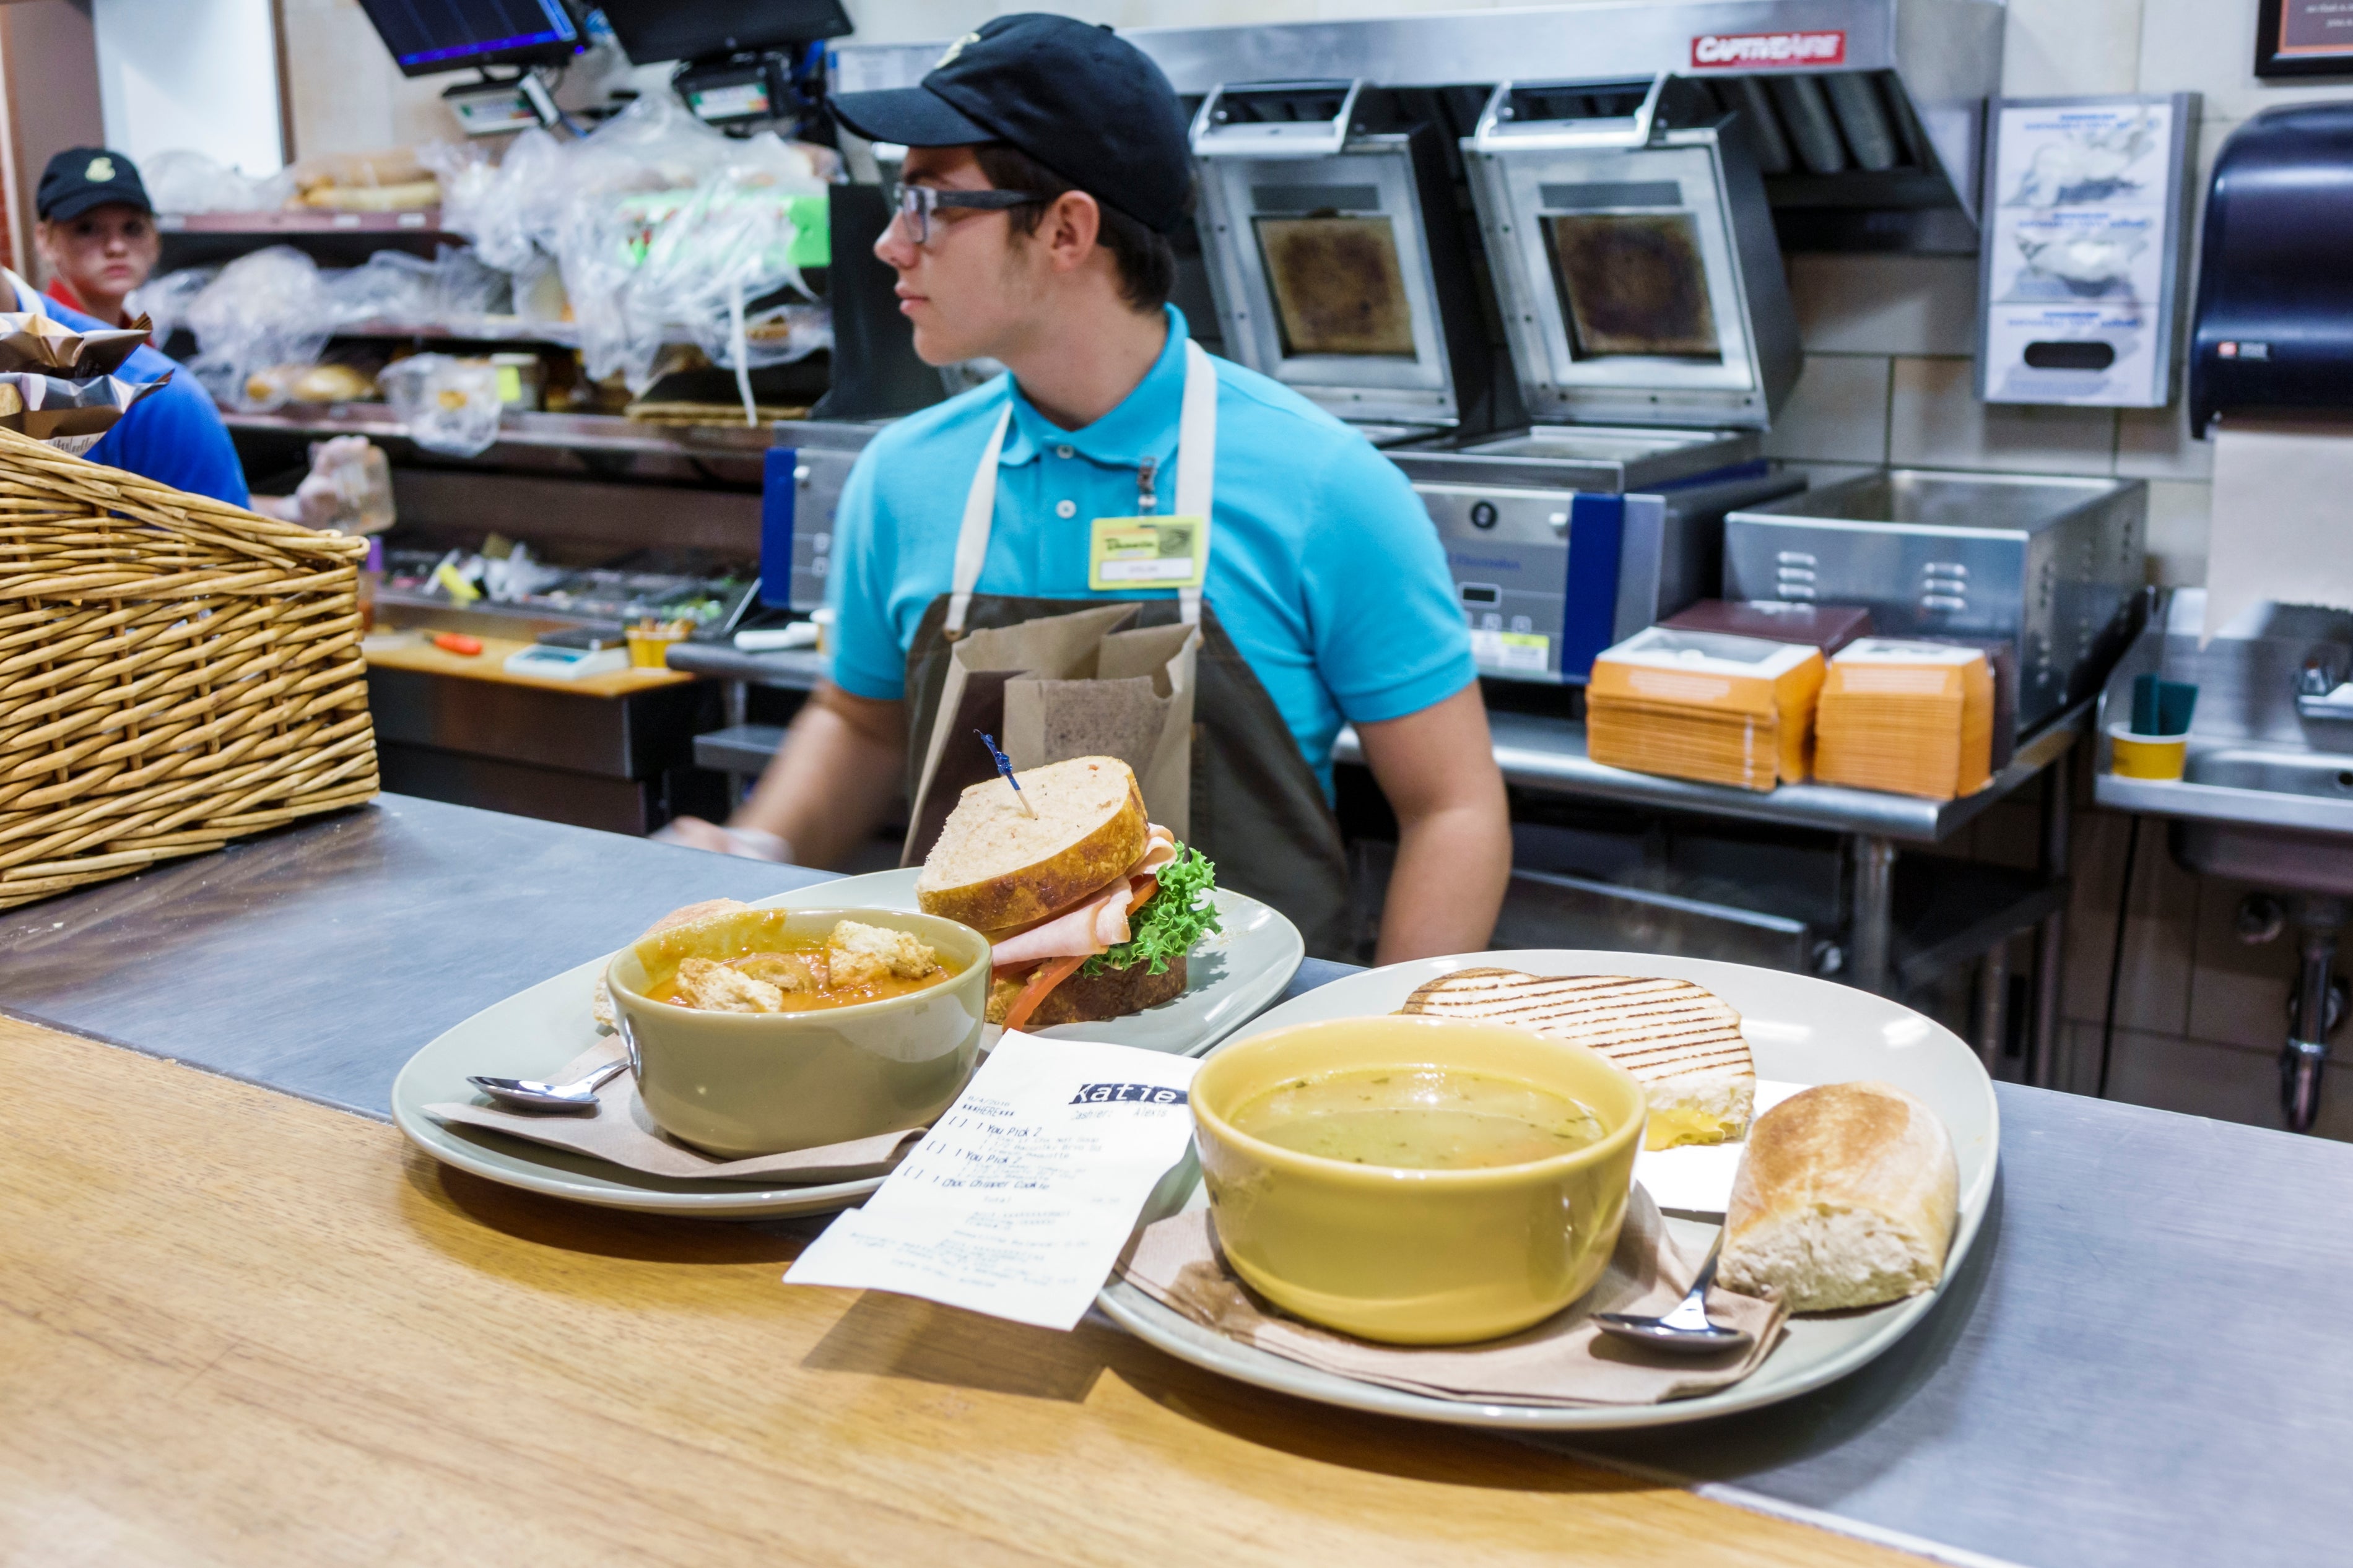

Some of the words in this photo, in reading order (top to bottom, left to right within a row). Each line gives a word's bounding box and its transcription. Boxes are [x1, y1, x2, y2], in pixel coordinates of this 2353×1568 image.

[1073, 1083, 1177, 1104] Katie
[986, 1124, 1004, 1135] You
[965, 1151, 983, 1162] You
